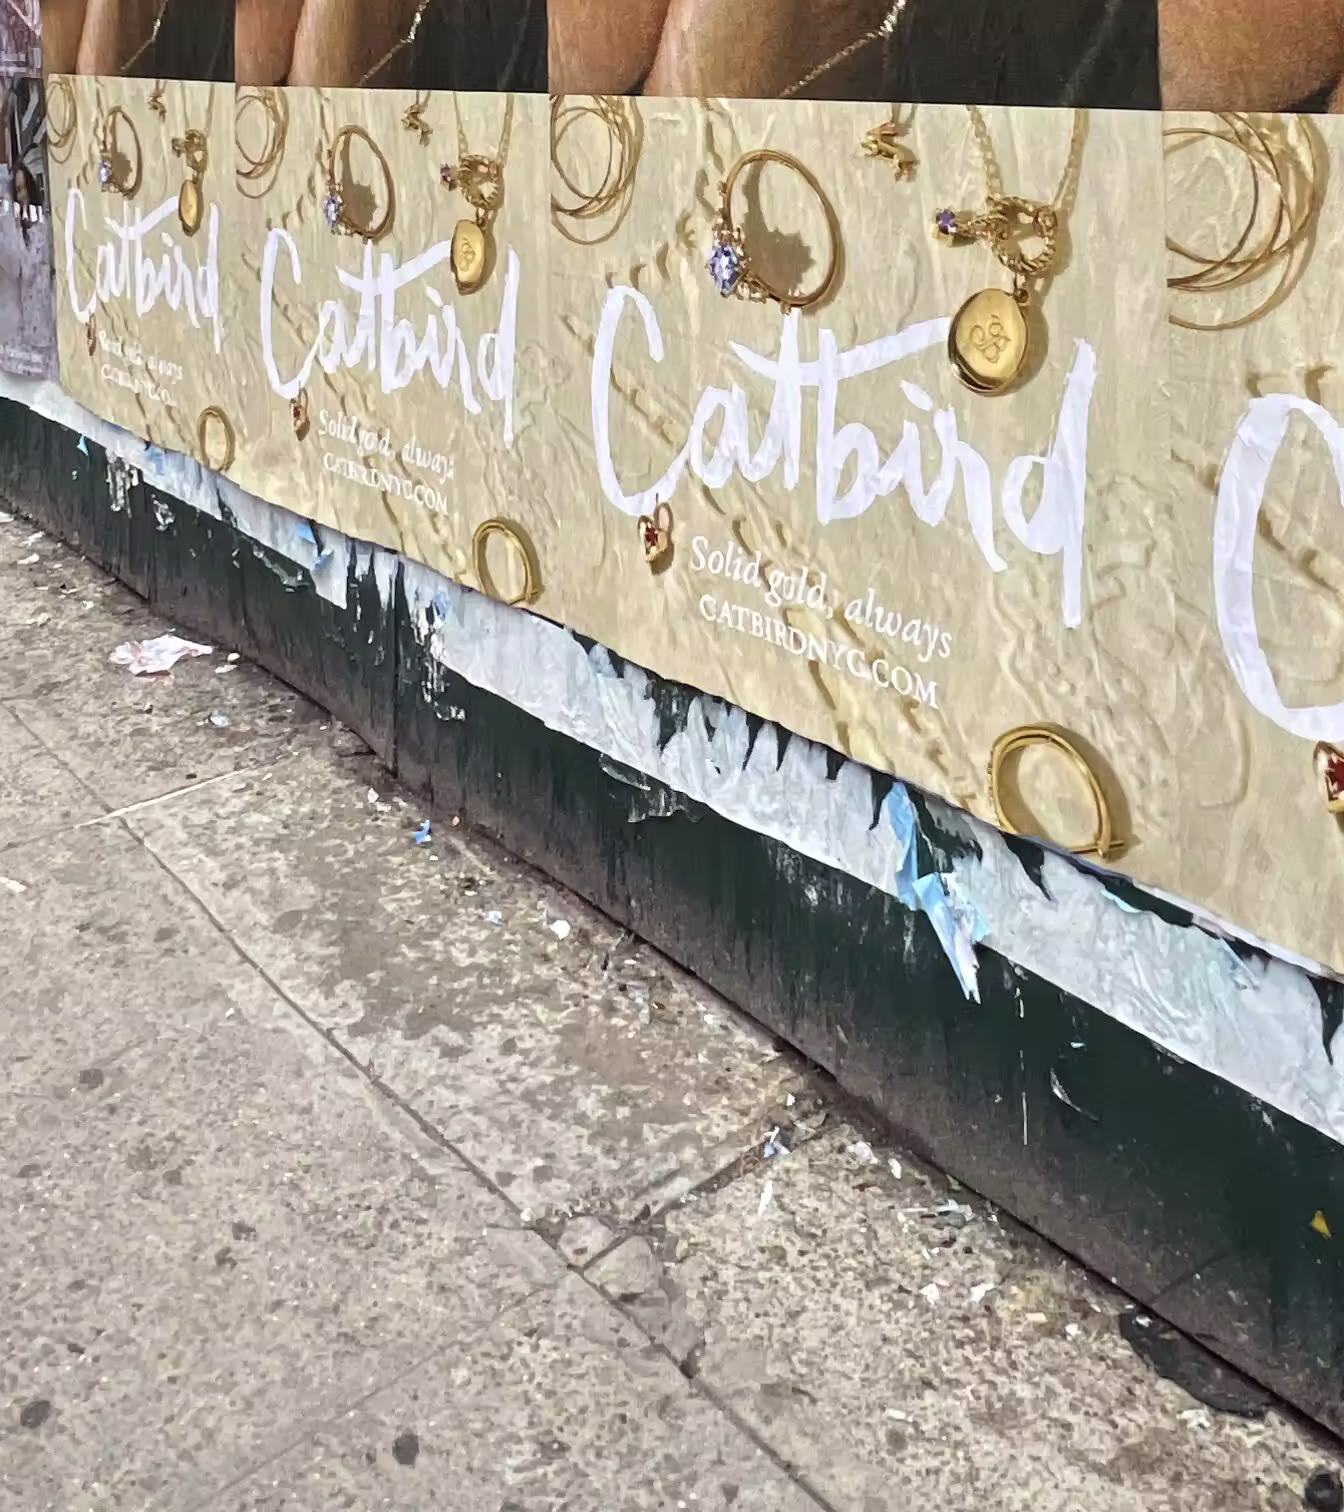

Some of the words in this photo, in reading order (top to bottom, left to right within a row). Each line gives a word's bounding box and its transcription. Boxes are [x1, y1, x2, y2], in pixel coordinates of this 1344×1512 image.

[64, 187, 220, 354] Catbird
[260, 227, 521, 449] Catbird
[318, 409, 358, 444] Solid
[591, 285, 1099, 629] Catbird
[688, 536, 761, 588] Solid
[764, 566, 833, 620] gold,
[844, 587, 953, 663] always
